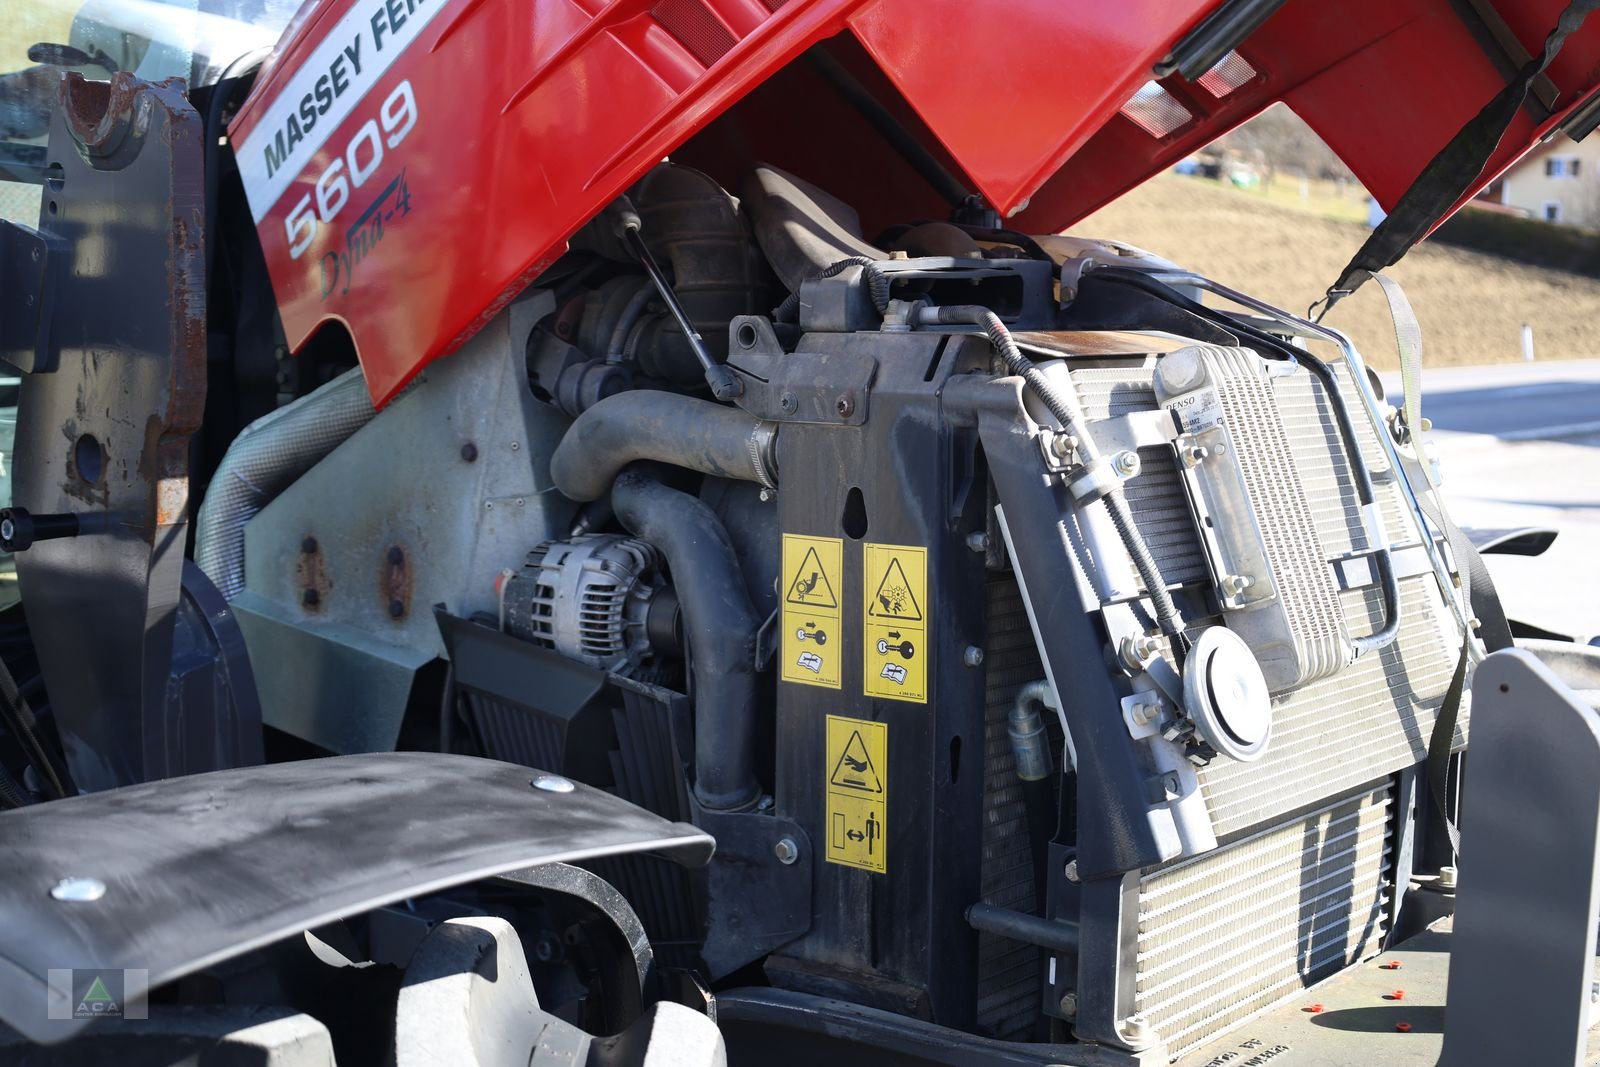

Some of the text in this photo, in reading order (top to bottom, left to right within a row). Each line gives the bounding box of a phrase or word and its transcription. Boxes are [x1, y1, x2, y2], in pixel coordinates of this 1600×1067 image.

[263, 33, 361, 180] MASSEY
[284, 79, 418, 260] 5609
[320, 167, 412, 301] Dyna-4
